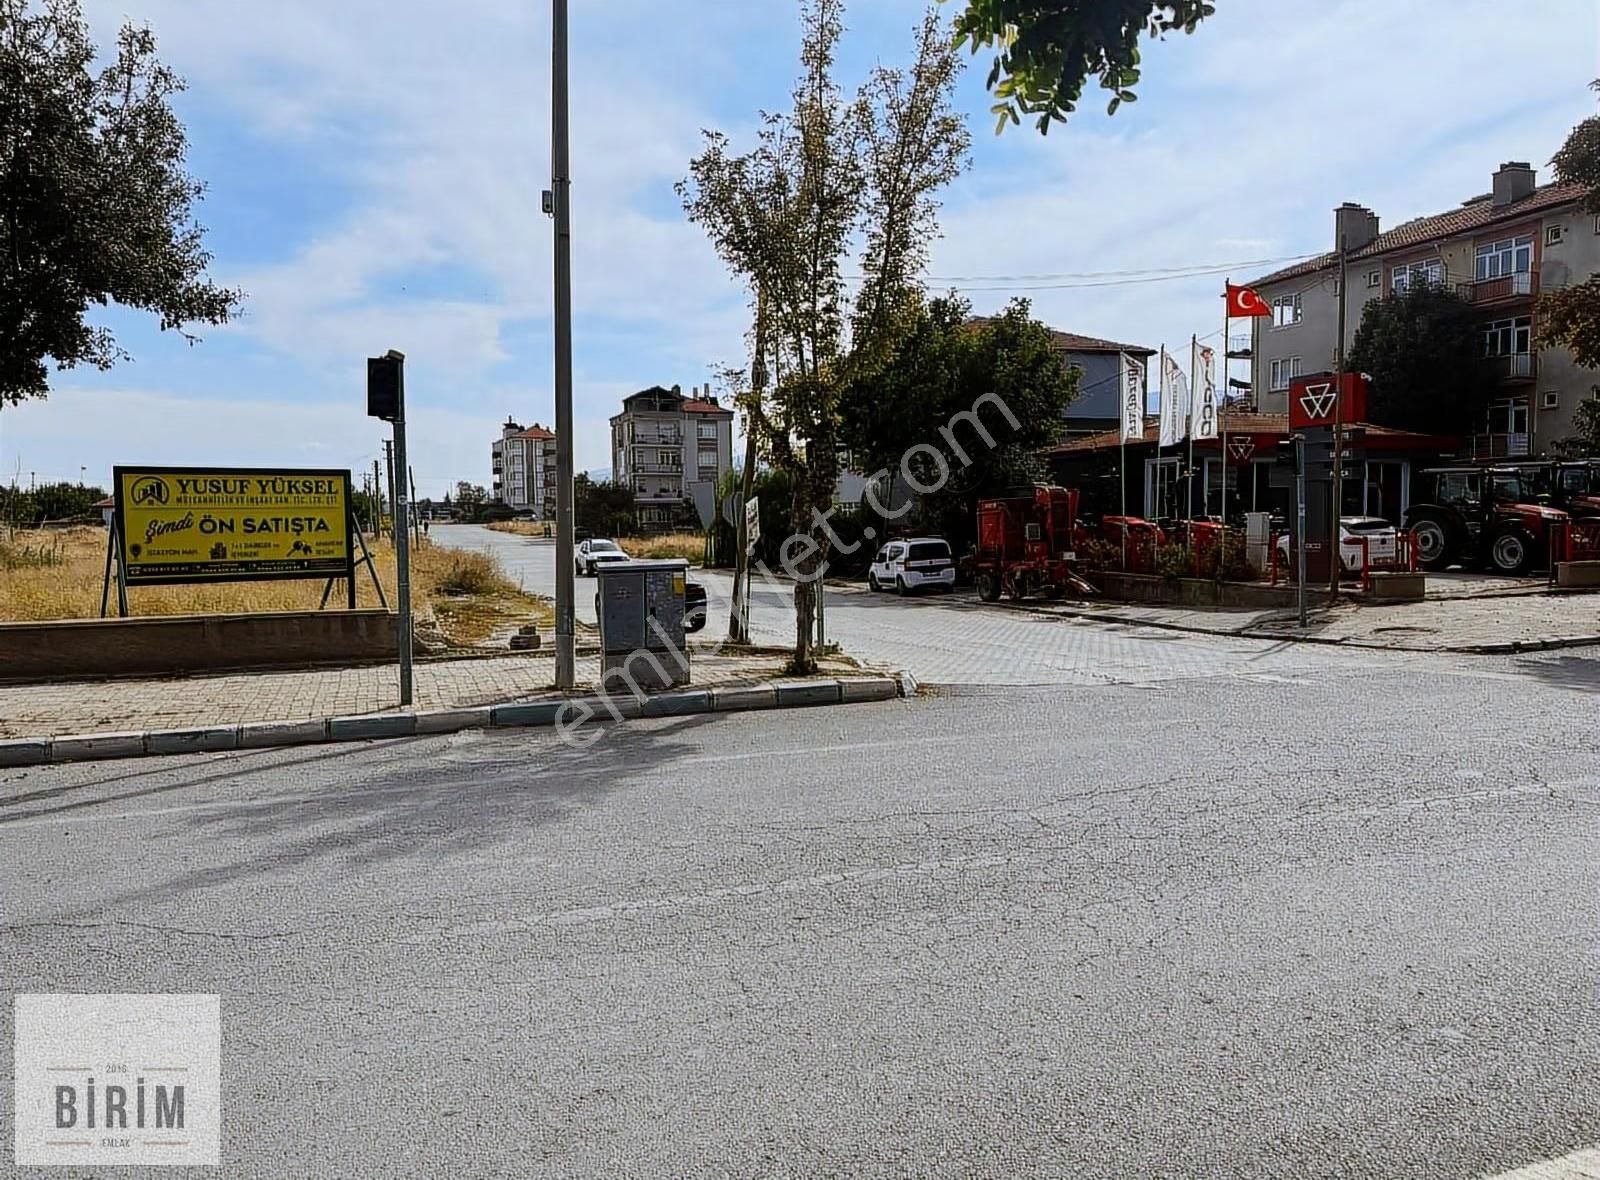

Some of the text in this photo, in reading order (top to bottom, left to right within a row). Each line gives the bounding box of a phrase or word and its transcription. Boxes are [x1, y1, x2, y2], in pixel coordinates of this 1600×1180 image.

[176, 477, 338, 494] YUSUF YÜKSEL
[145, 511, 194, 544] Şimdi
[199, 515, 329, 536] ÖN SATIŞTA
